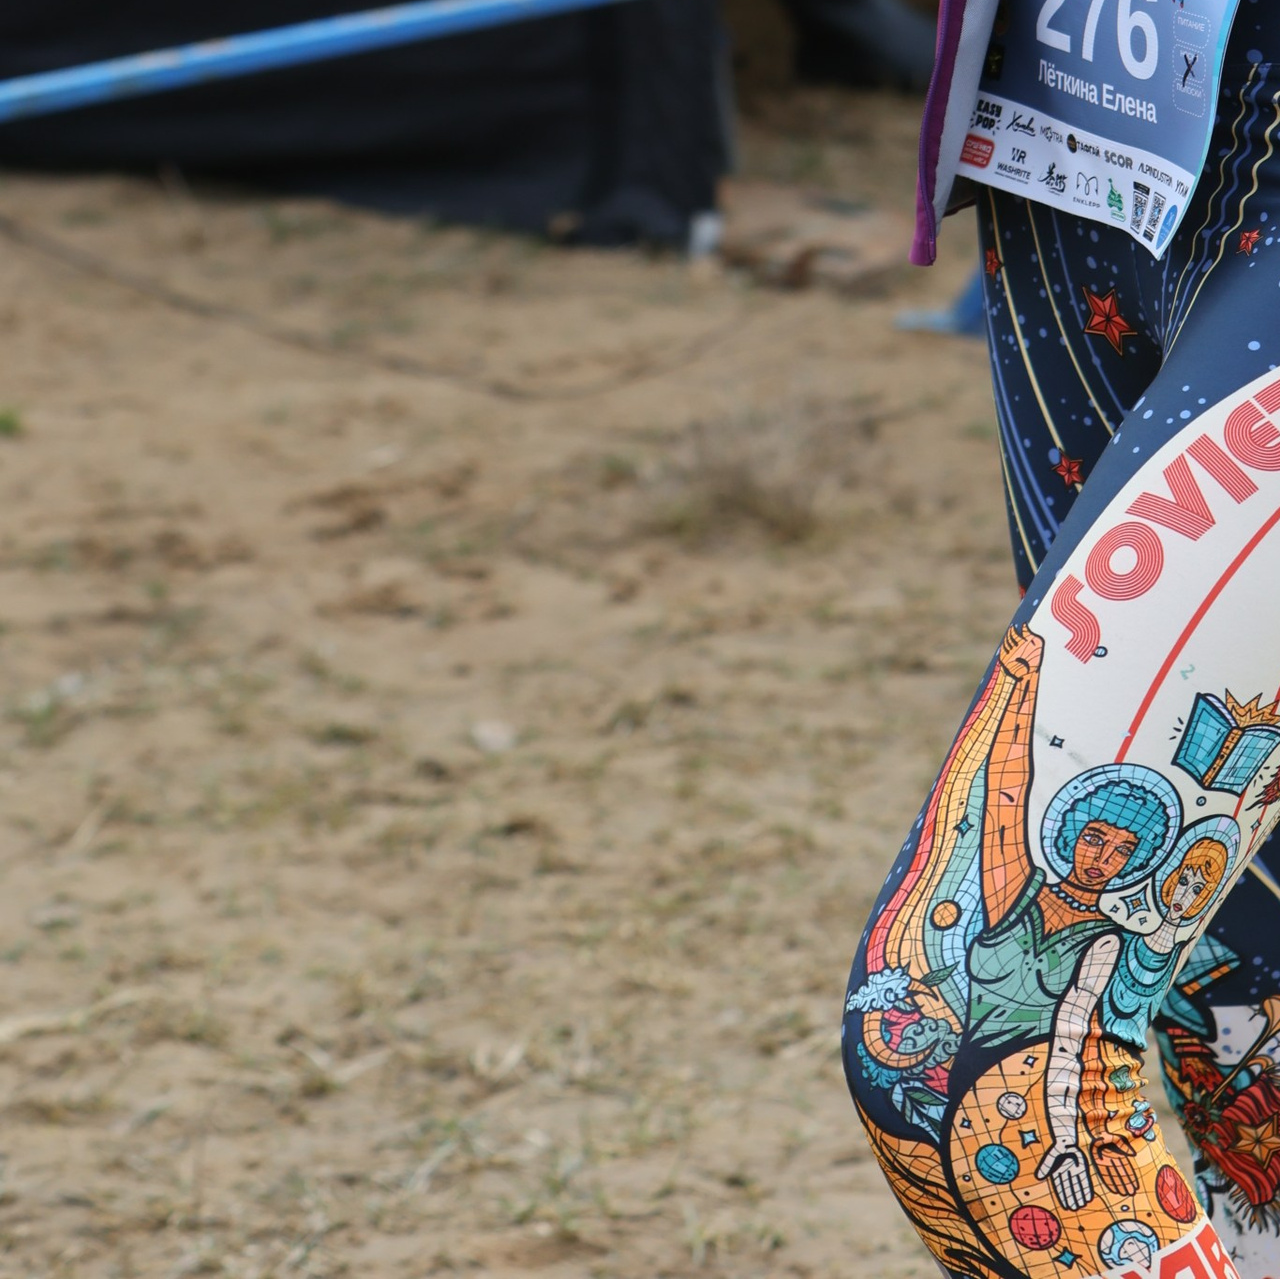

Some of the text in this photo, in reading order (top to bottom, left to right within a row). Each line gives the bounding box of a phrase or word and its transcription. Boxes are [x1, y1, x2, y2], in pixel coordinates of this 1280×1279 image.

[1038, 59, 1158, 124] Лёткина Елена
[1104, 150, 1134, 170] SCOR
[997, 162, 1031, 180] WASHRITE
